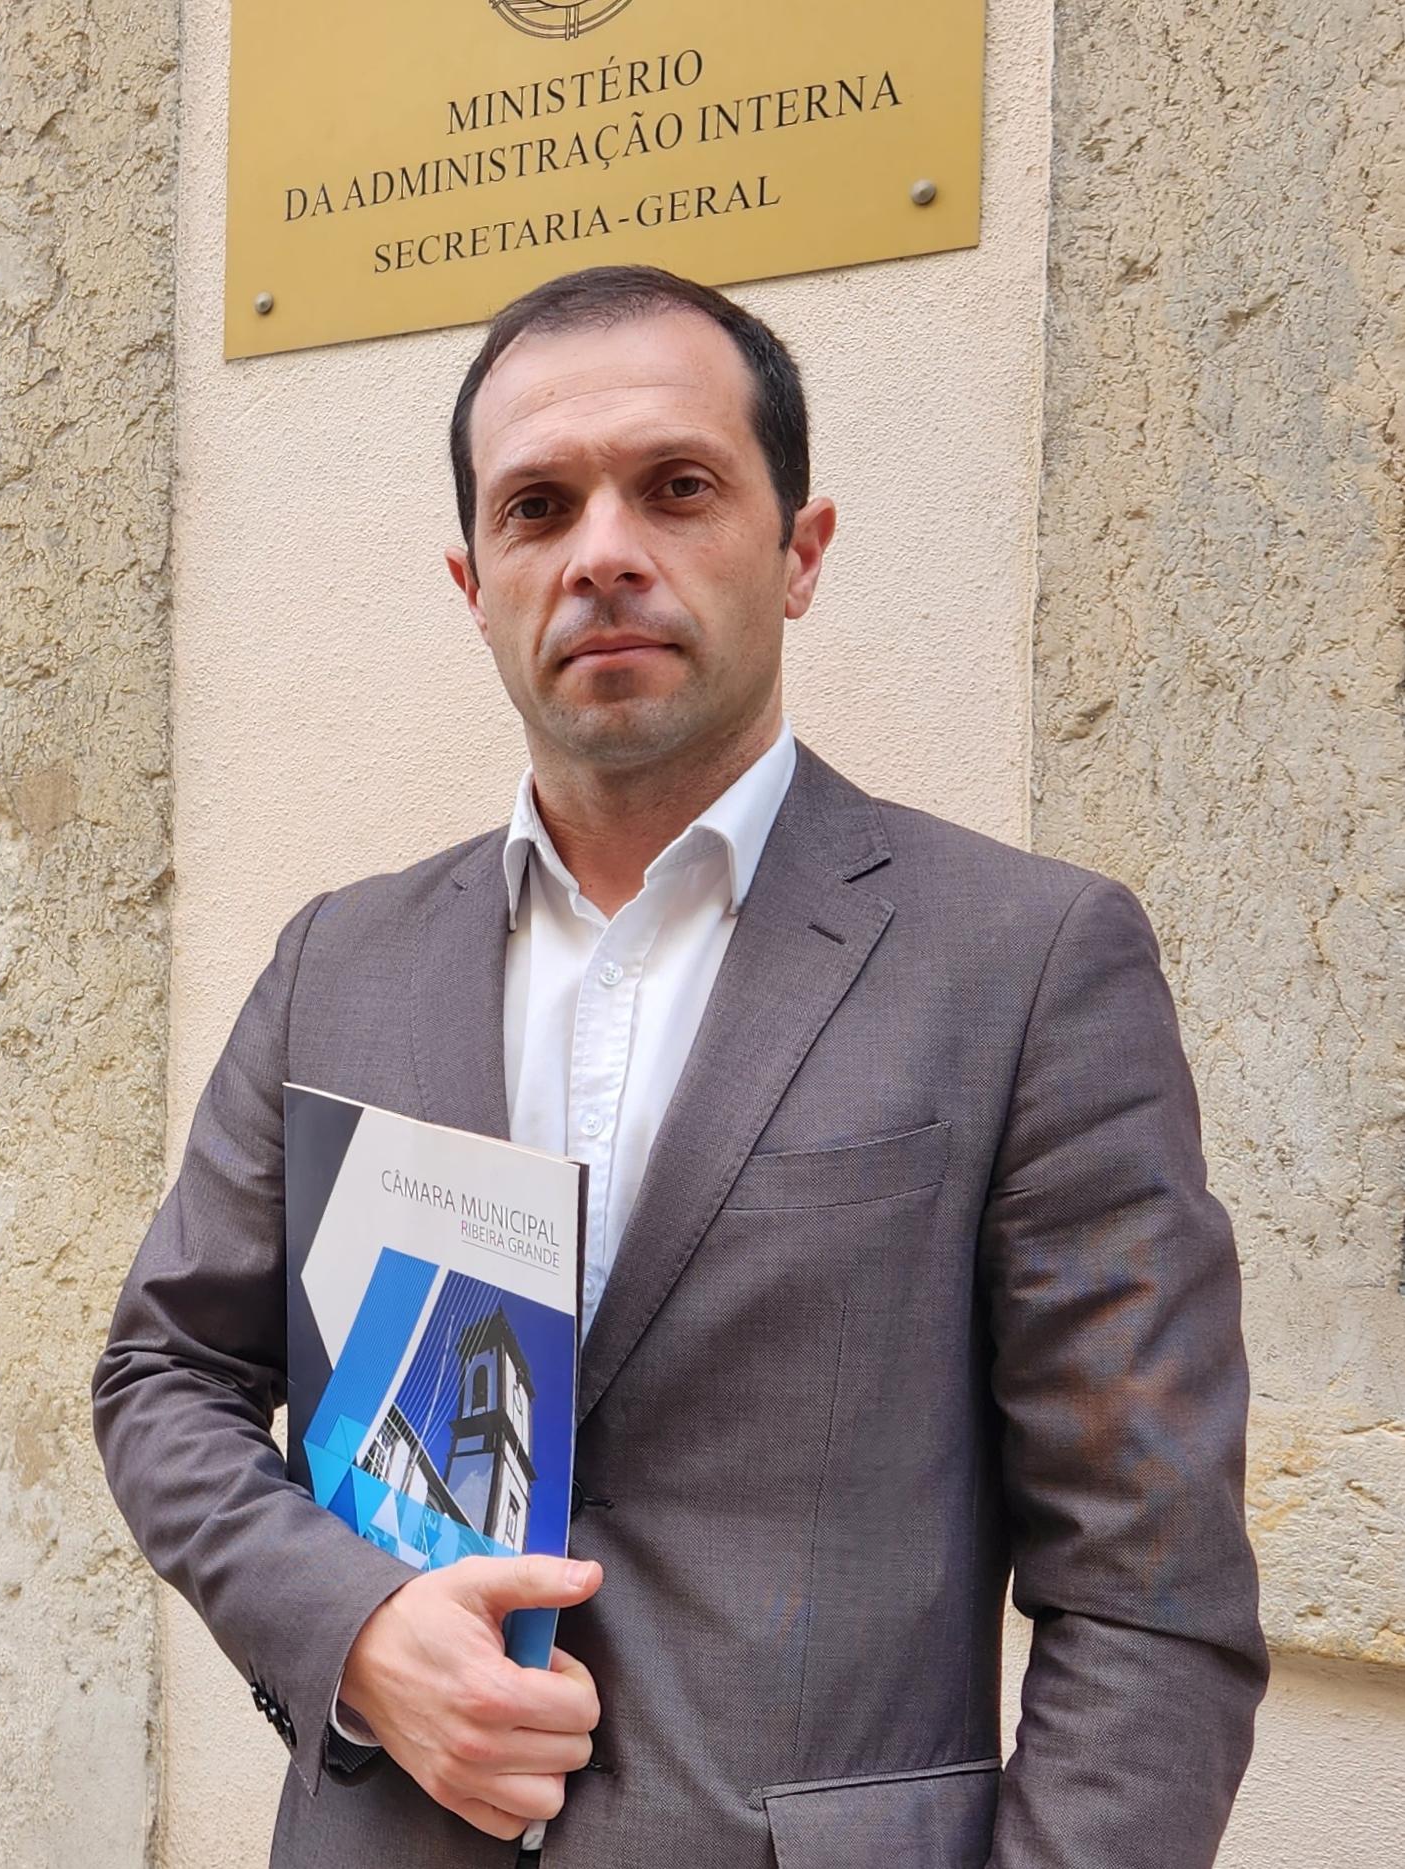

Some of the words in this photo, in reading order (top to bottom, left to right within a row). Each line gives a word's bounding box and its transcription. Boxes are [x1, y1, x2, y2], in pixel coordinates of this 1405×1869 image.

[446, 48, 704, 136] MINISTÉRIO
[284, 181, 334, 222] DA
[342, 111, 683, 214] ADMINISTRAÇÃO
[698, 70, 902, 144] INTERNA
[381, 1169, 455, 1213] CÂMARA
[461, 1193, 560, 1247] MUNICIPAL
[461, 1219, 505, 1249] RIBEIRA
[508, 1236, 560, 1269] GRANDE
